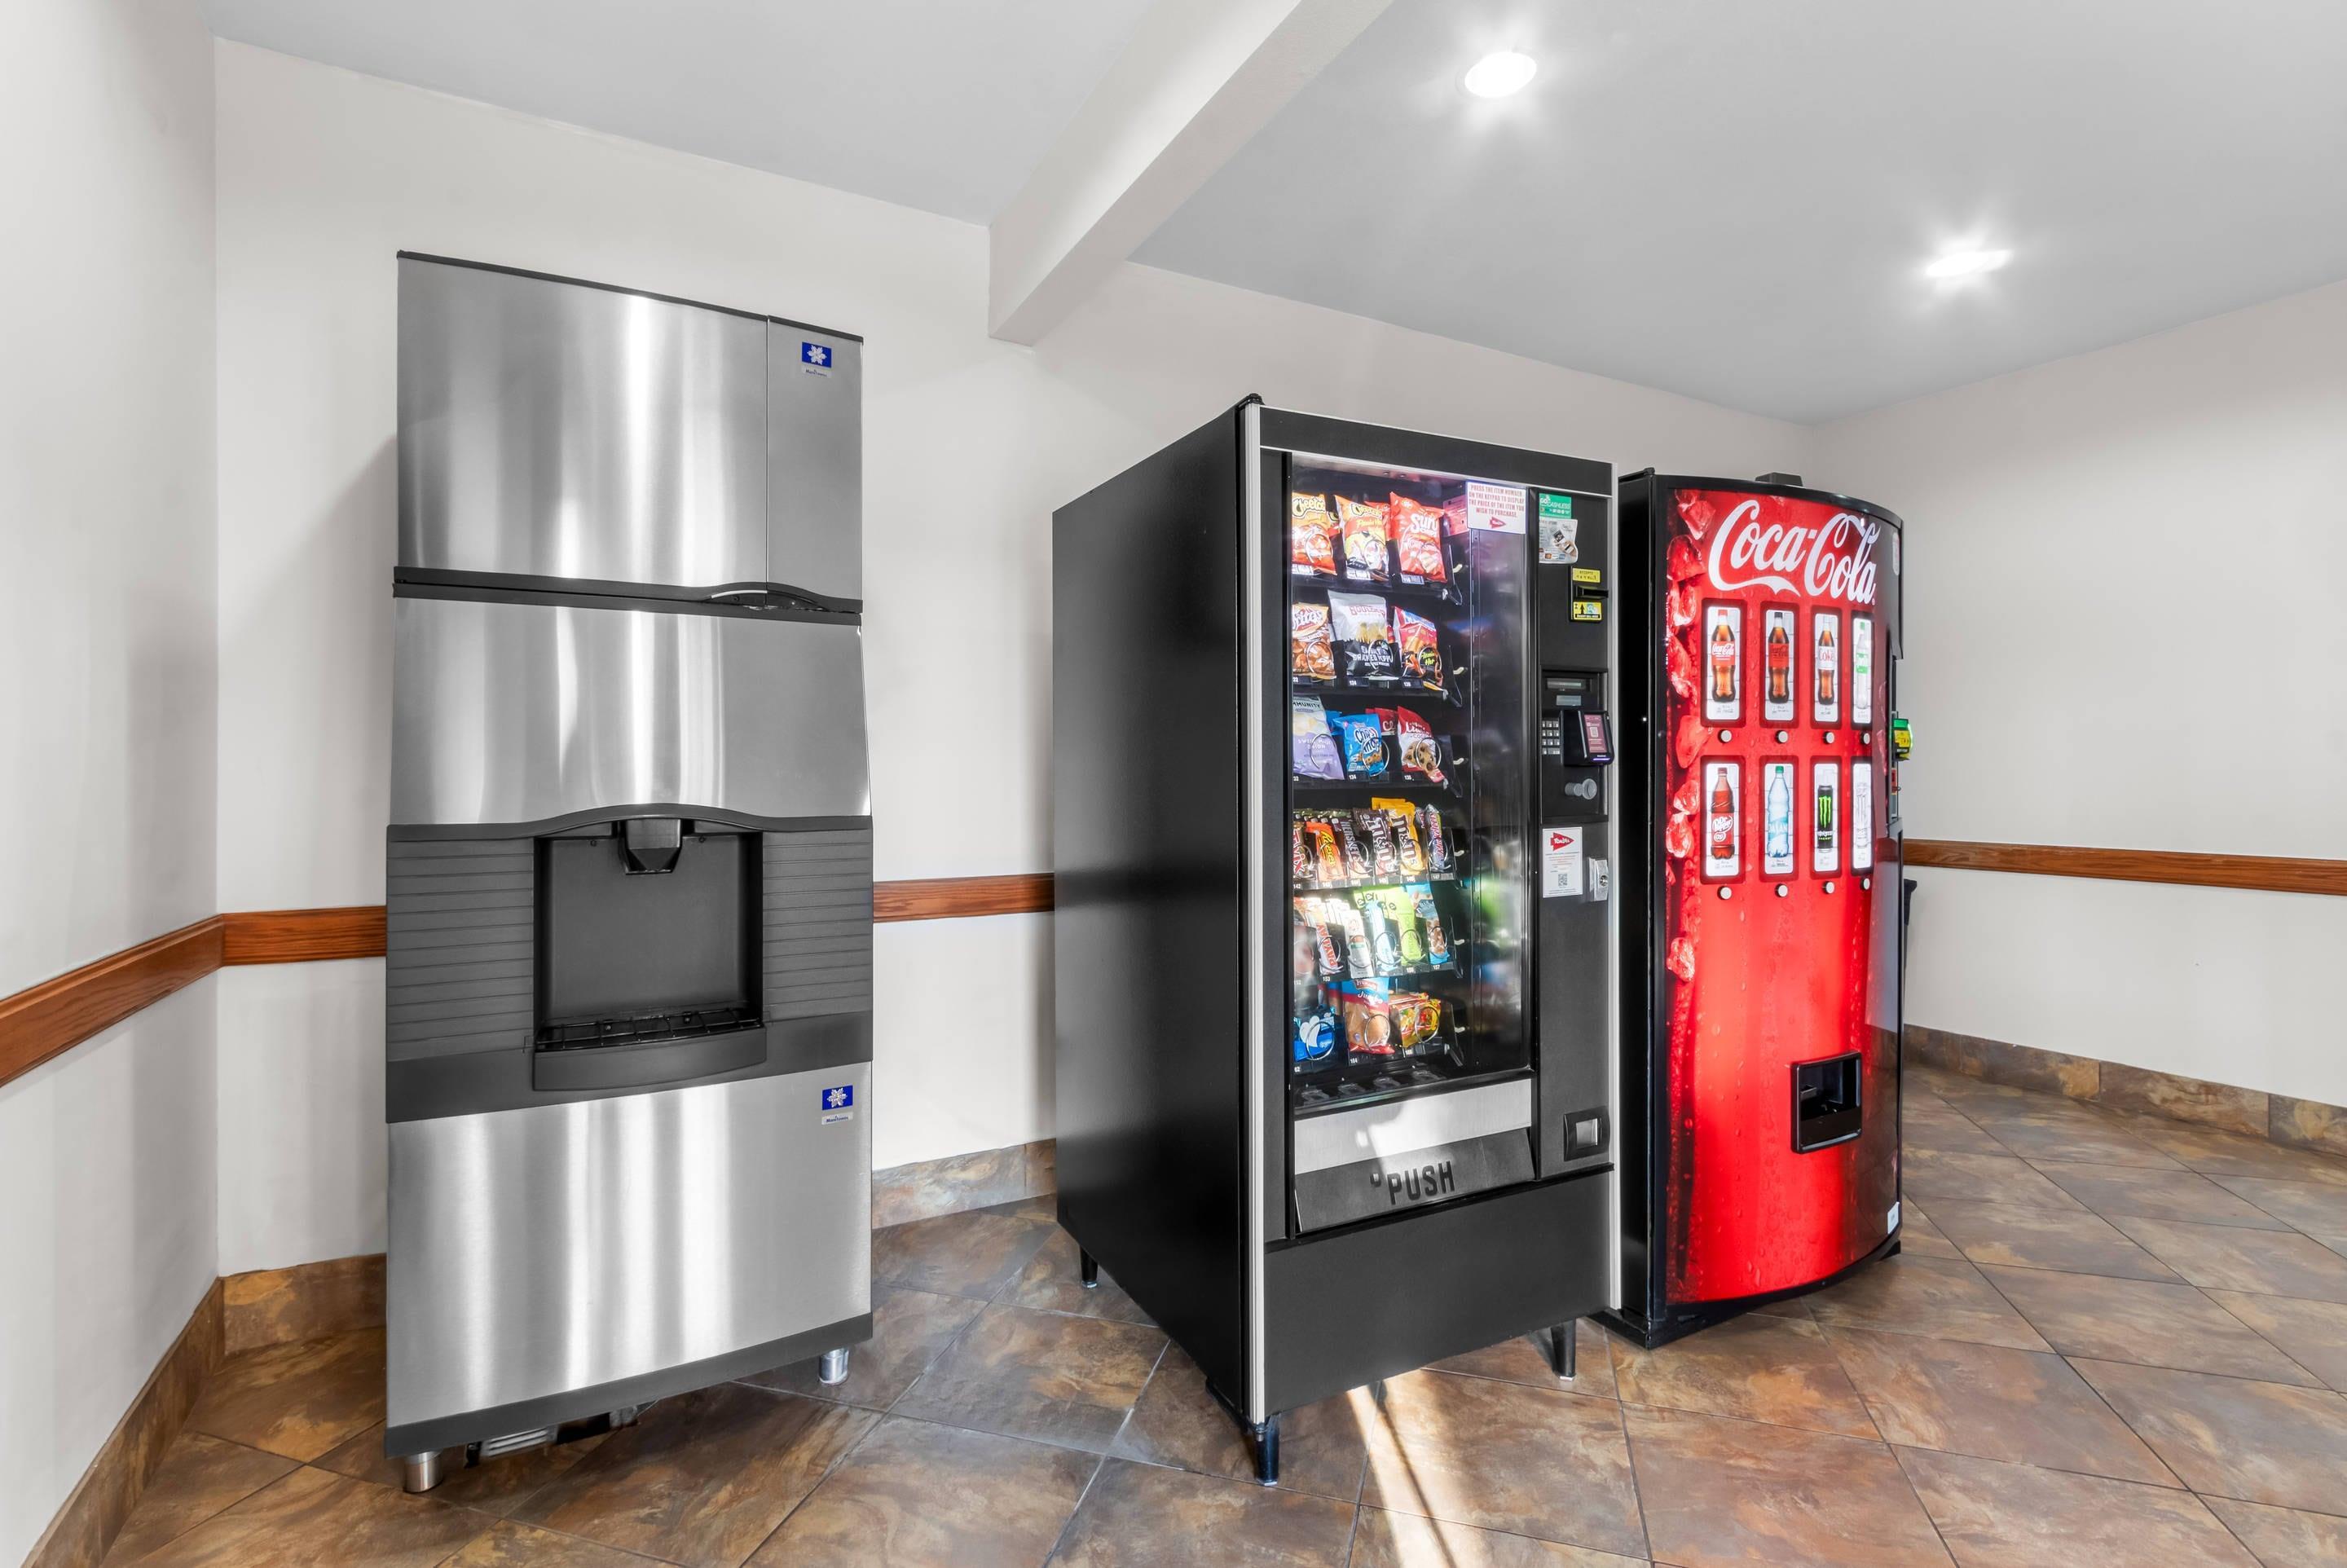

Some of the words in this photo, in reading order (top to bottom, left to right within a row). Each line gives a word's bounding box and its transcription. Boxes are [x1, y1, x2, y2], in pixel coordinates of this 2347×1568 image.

[1484, 493, 1500, 501] KEYPAD
[1507, 496, 1525, 504] DISPLAY
[1504, 488, 1522, 496] NUMBER
[1708, 499, 1881, 606] Coca-Cola
[1386, 1160, 1455, 1205] PUSH
